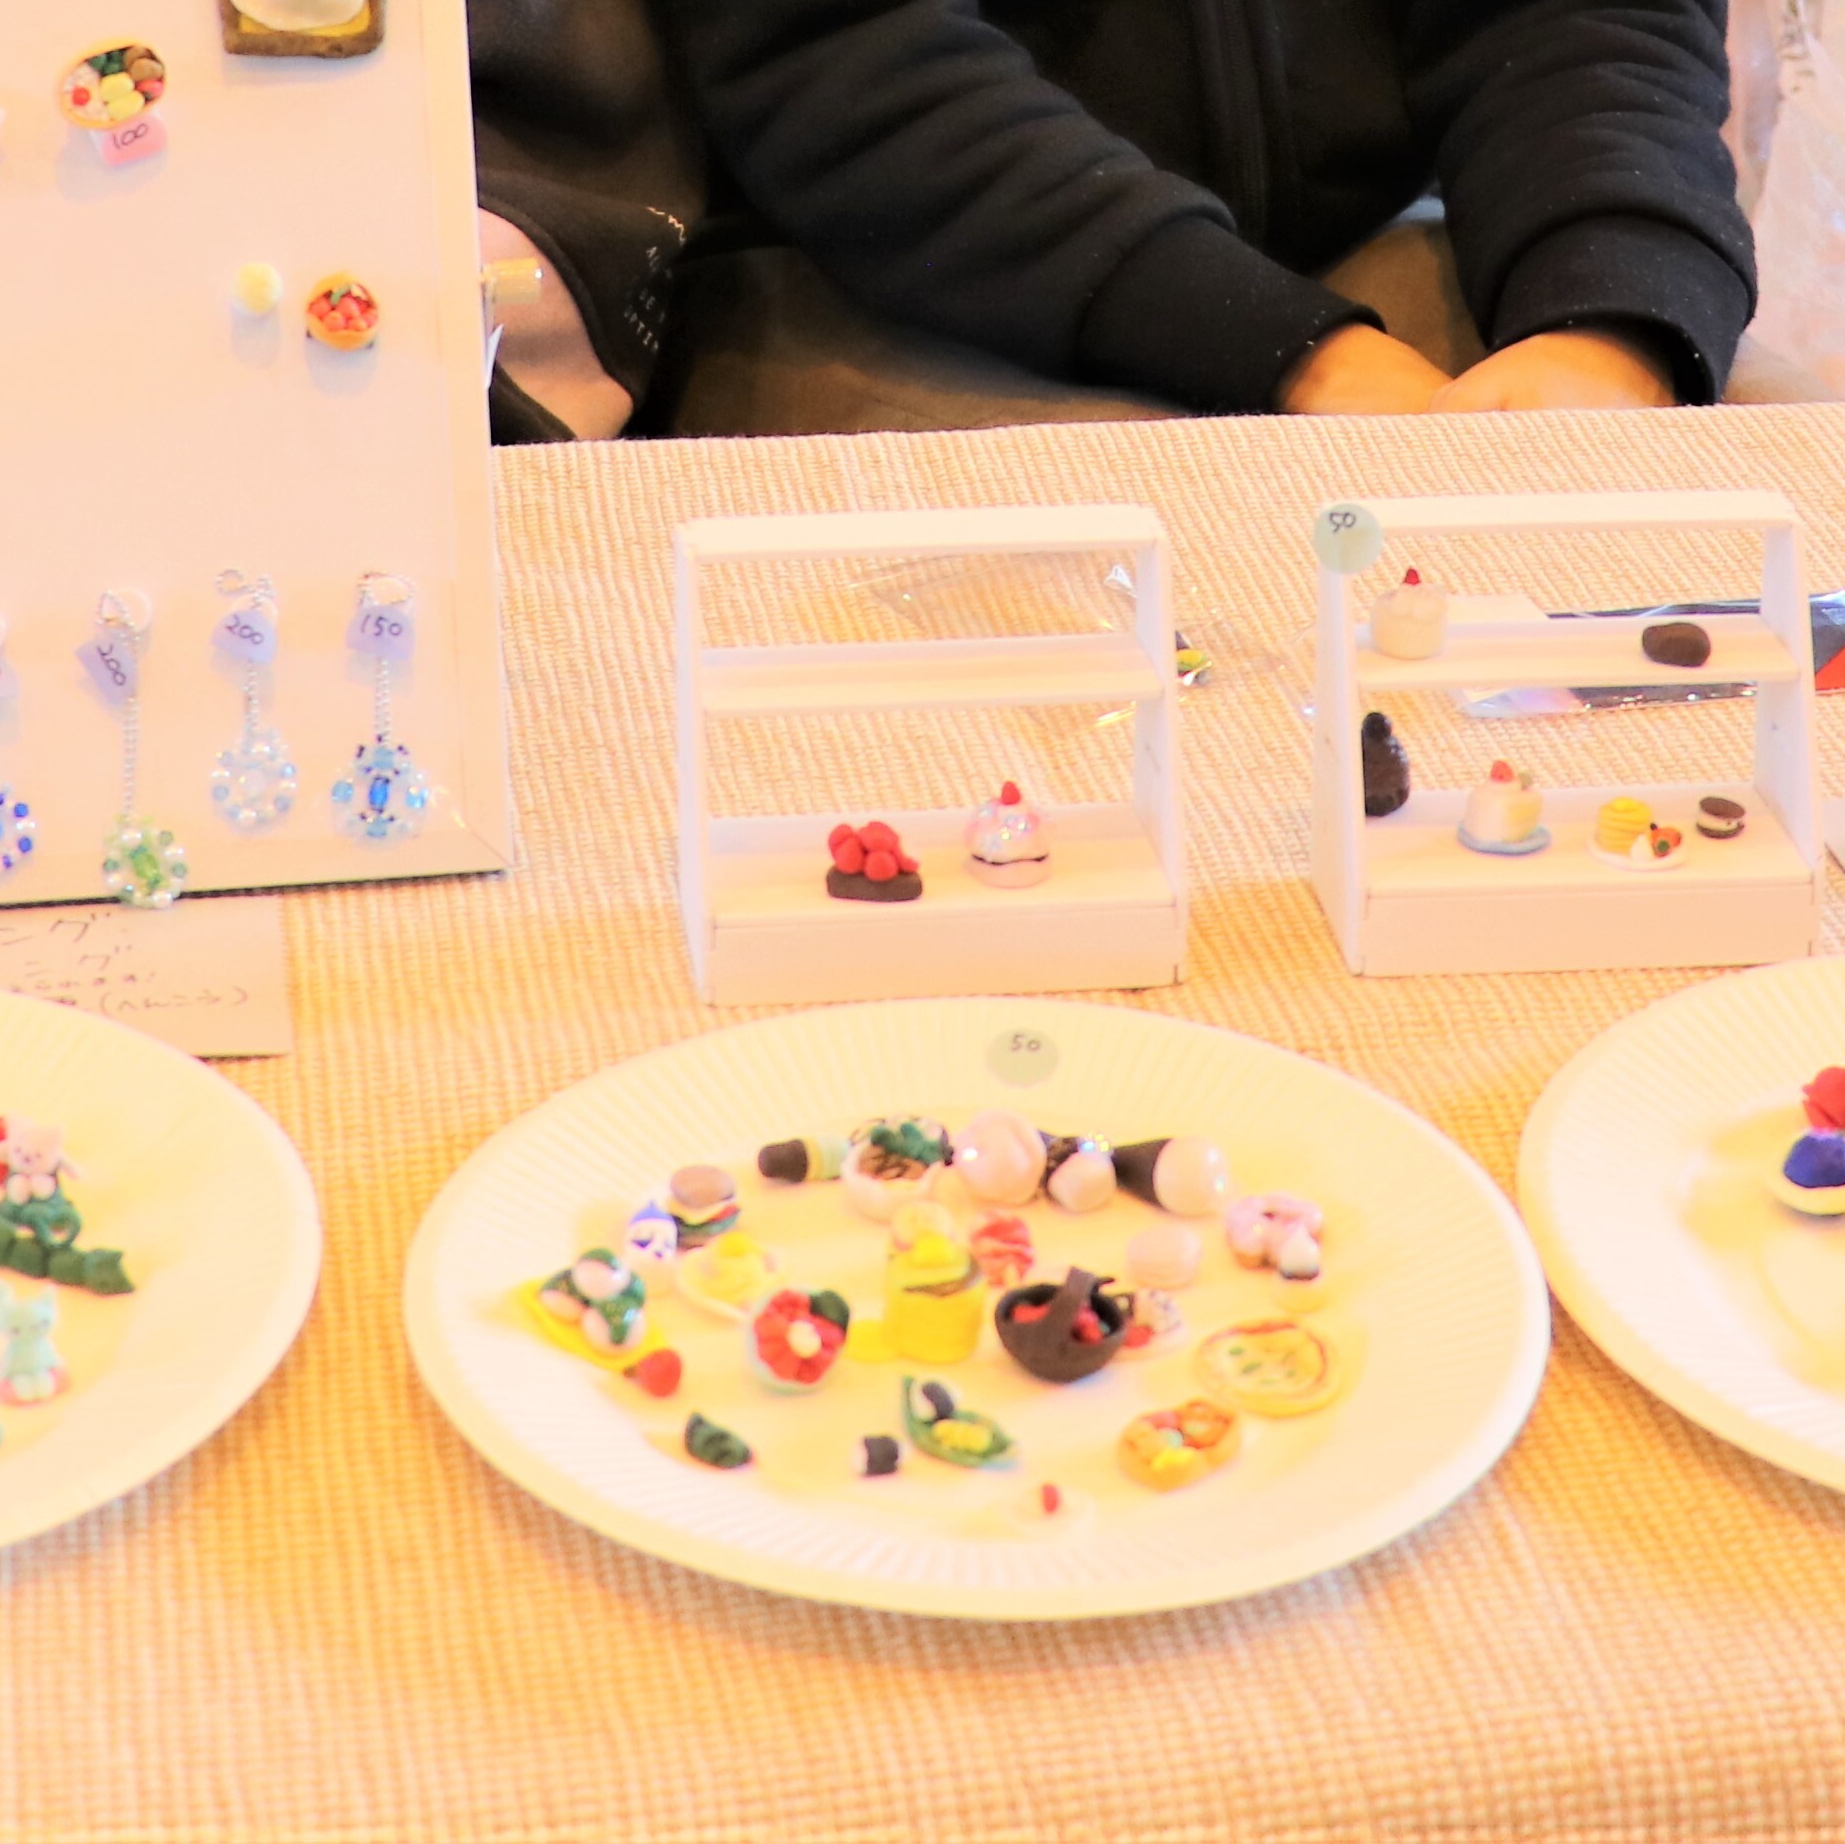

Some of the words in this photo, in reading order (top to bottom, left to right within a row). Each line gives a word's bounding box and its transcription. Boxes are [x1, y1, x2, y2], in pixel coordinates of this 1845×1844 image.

[110, 122, 151, 152] 100
[1329, 508, 1358, 534] 50
[224, 614, 266, 647] 200
[358, 612, 404, 639] 150
[95, 642, 128, 689] 200
[1009, 1033, 1042, 1054] 50
